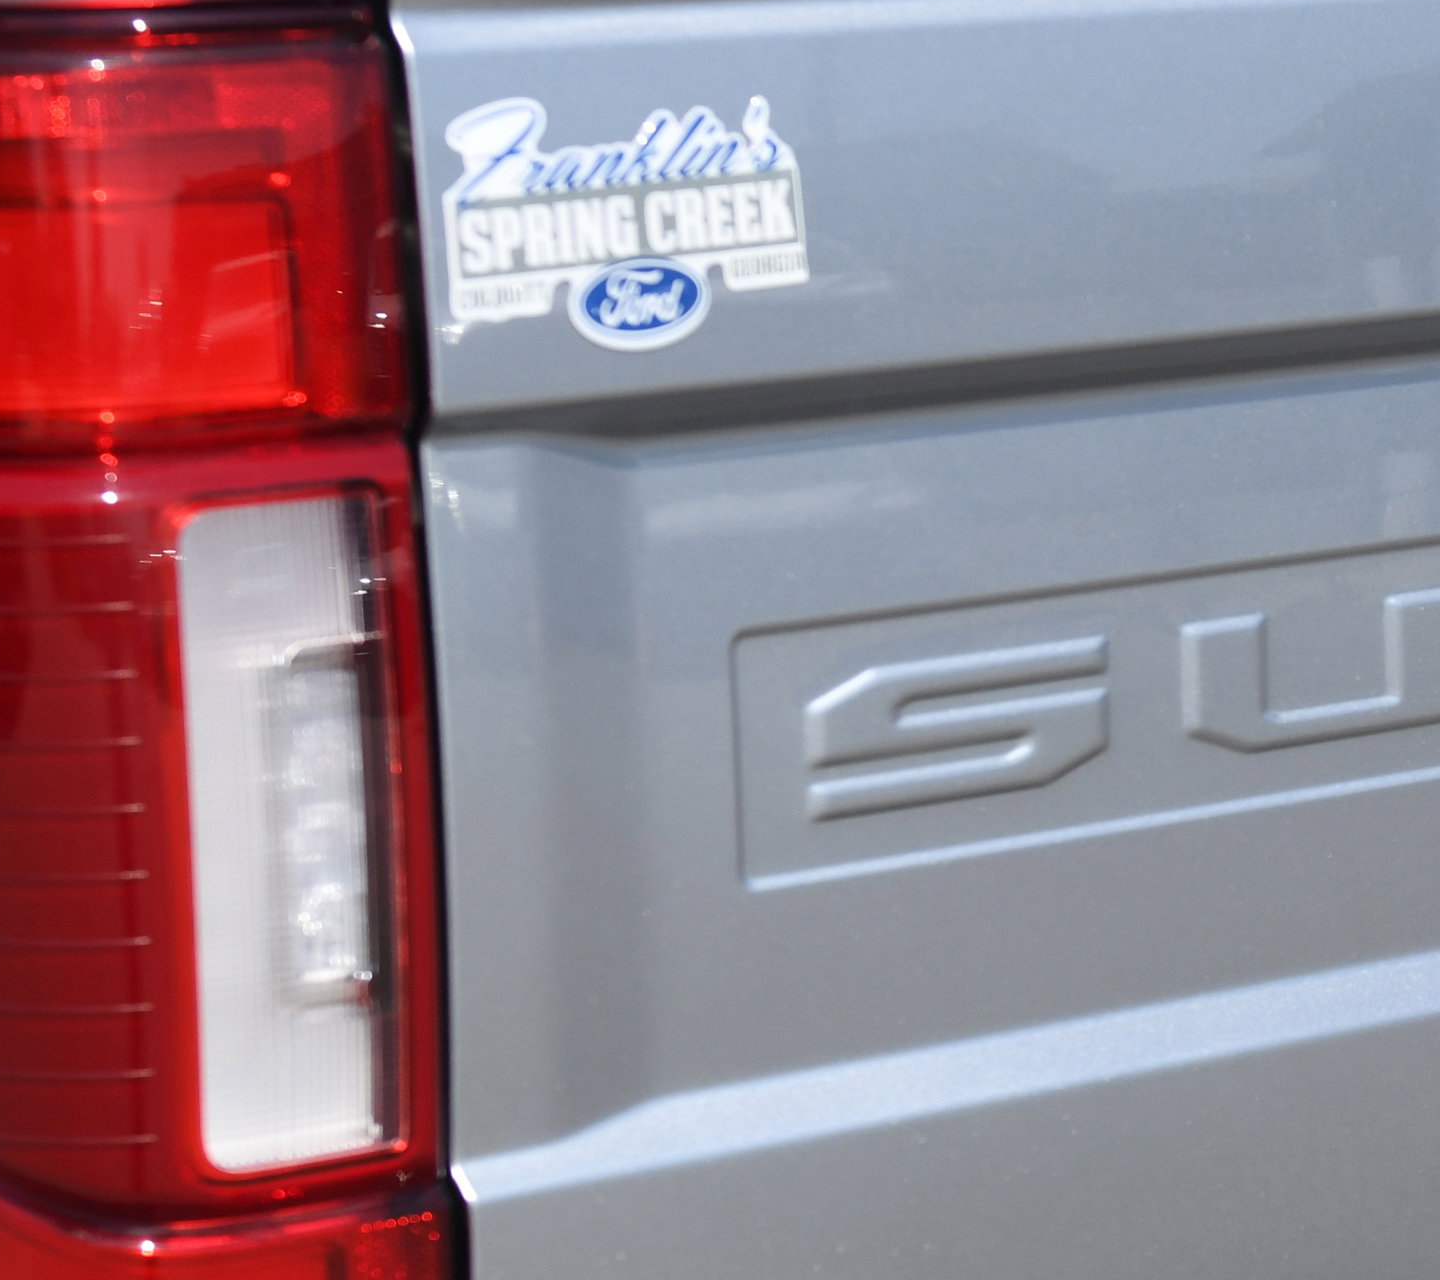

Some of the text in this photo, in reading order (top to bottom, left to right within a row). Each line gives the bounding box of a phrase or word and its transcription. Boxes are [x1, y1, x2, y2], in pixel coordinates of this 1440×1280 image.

[458, 100, 779, 208] Franklin's
[460, 177, 798, 275] SPRING CREEK
[596, 269, 686, 328] Ford
